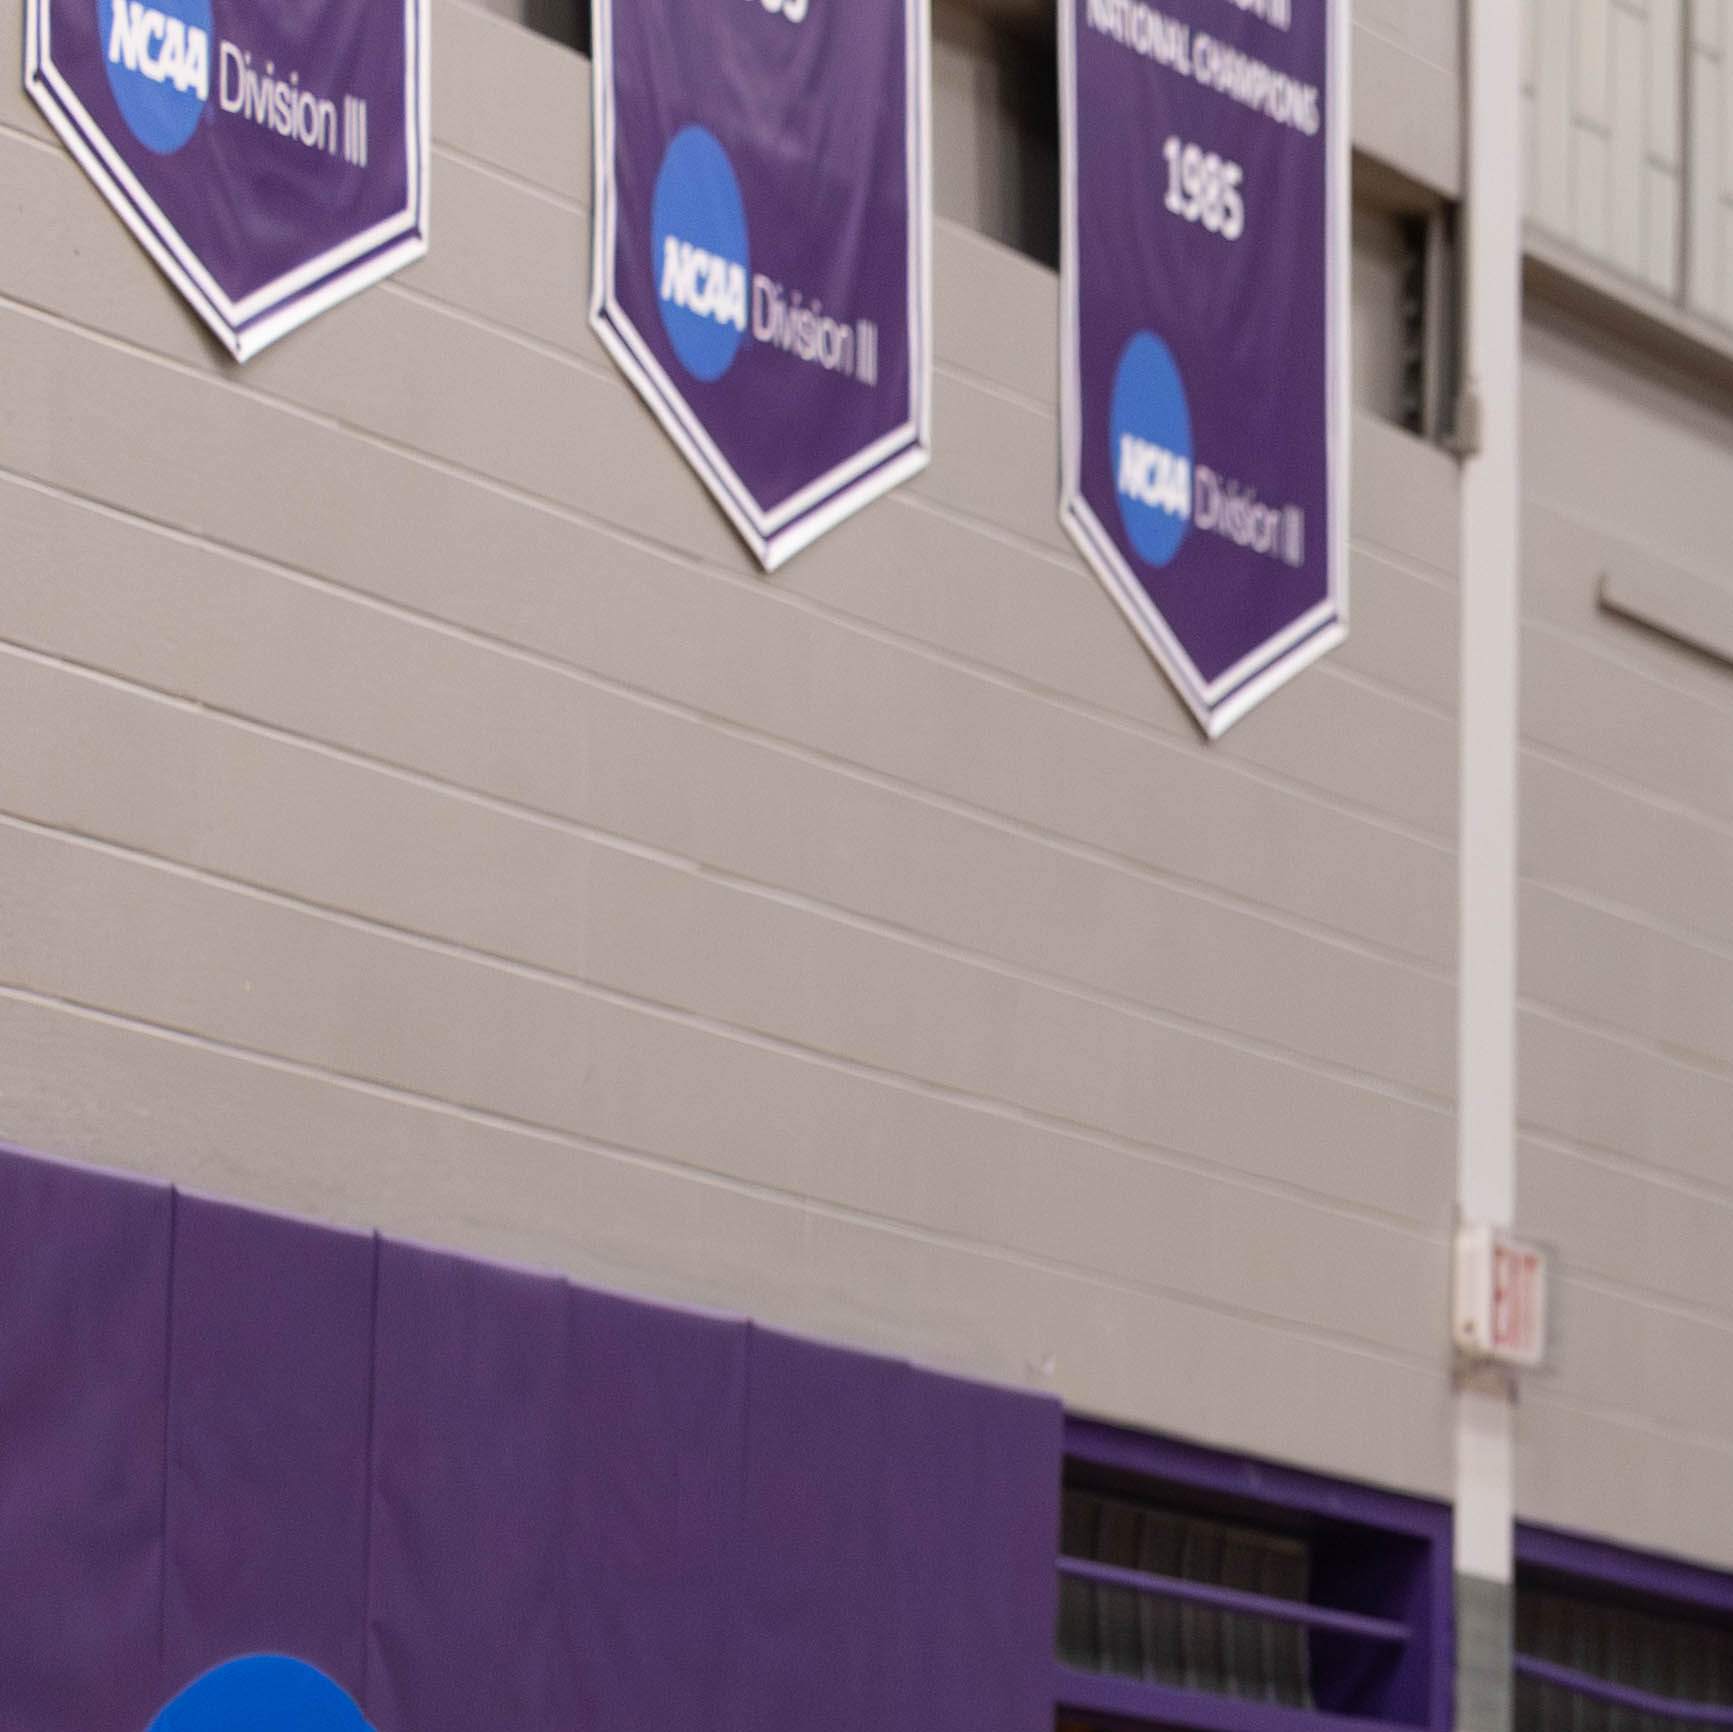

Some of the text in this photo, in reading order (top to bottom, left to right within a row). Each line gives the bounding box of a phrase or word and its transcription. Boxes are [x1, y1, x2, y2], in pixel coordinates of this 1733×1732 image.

[109, 0, 208, 100] NCAA
[219, 40, 337, 156] Division
[1163, 136, 1244, 239] 1985
[661, 236, 747, 332] NCAA
[752, 272, 854, 378] Division
